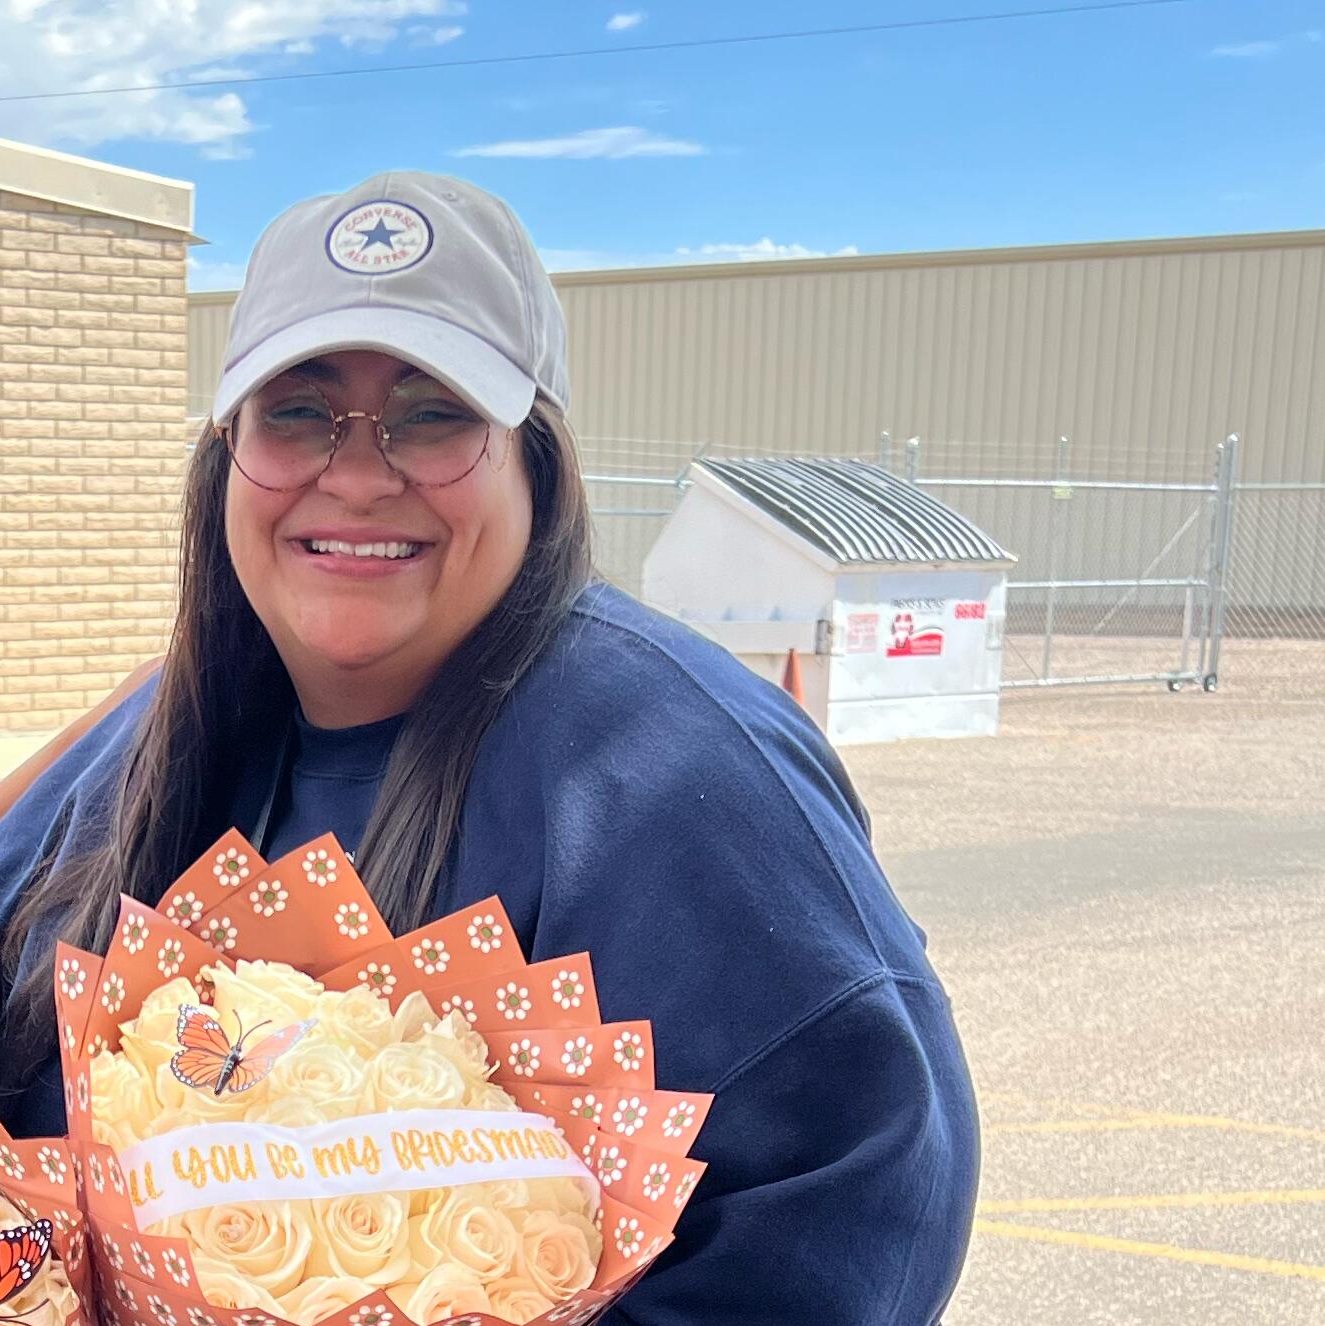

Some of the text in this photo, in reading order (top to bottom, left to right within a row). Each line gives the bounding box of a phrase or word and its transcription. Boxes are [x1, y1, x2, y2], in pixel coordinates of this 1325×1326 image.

[344, 207, 418, 233] CONVERSE
[344, 250, 411, 265] ALL STAR
